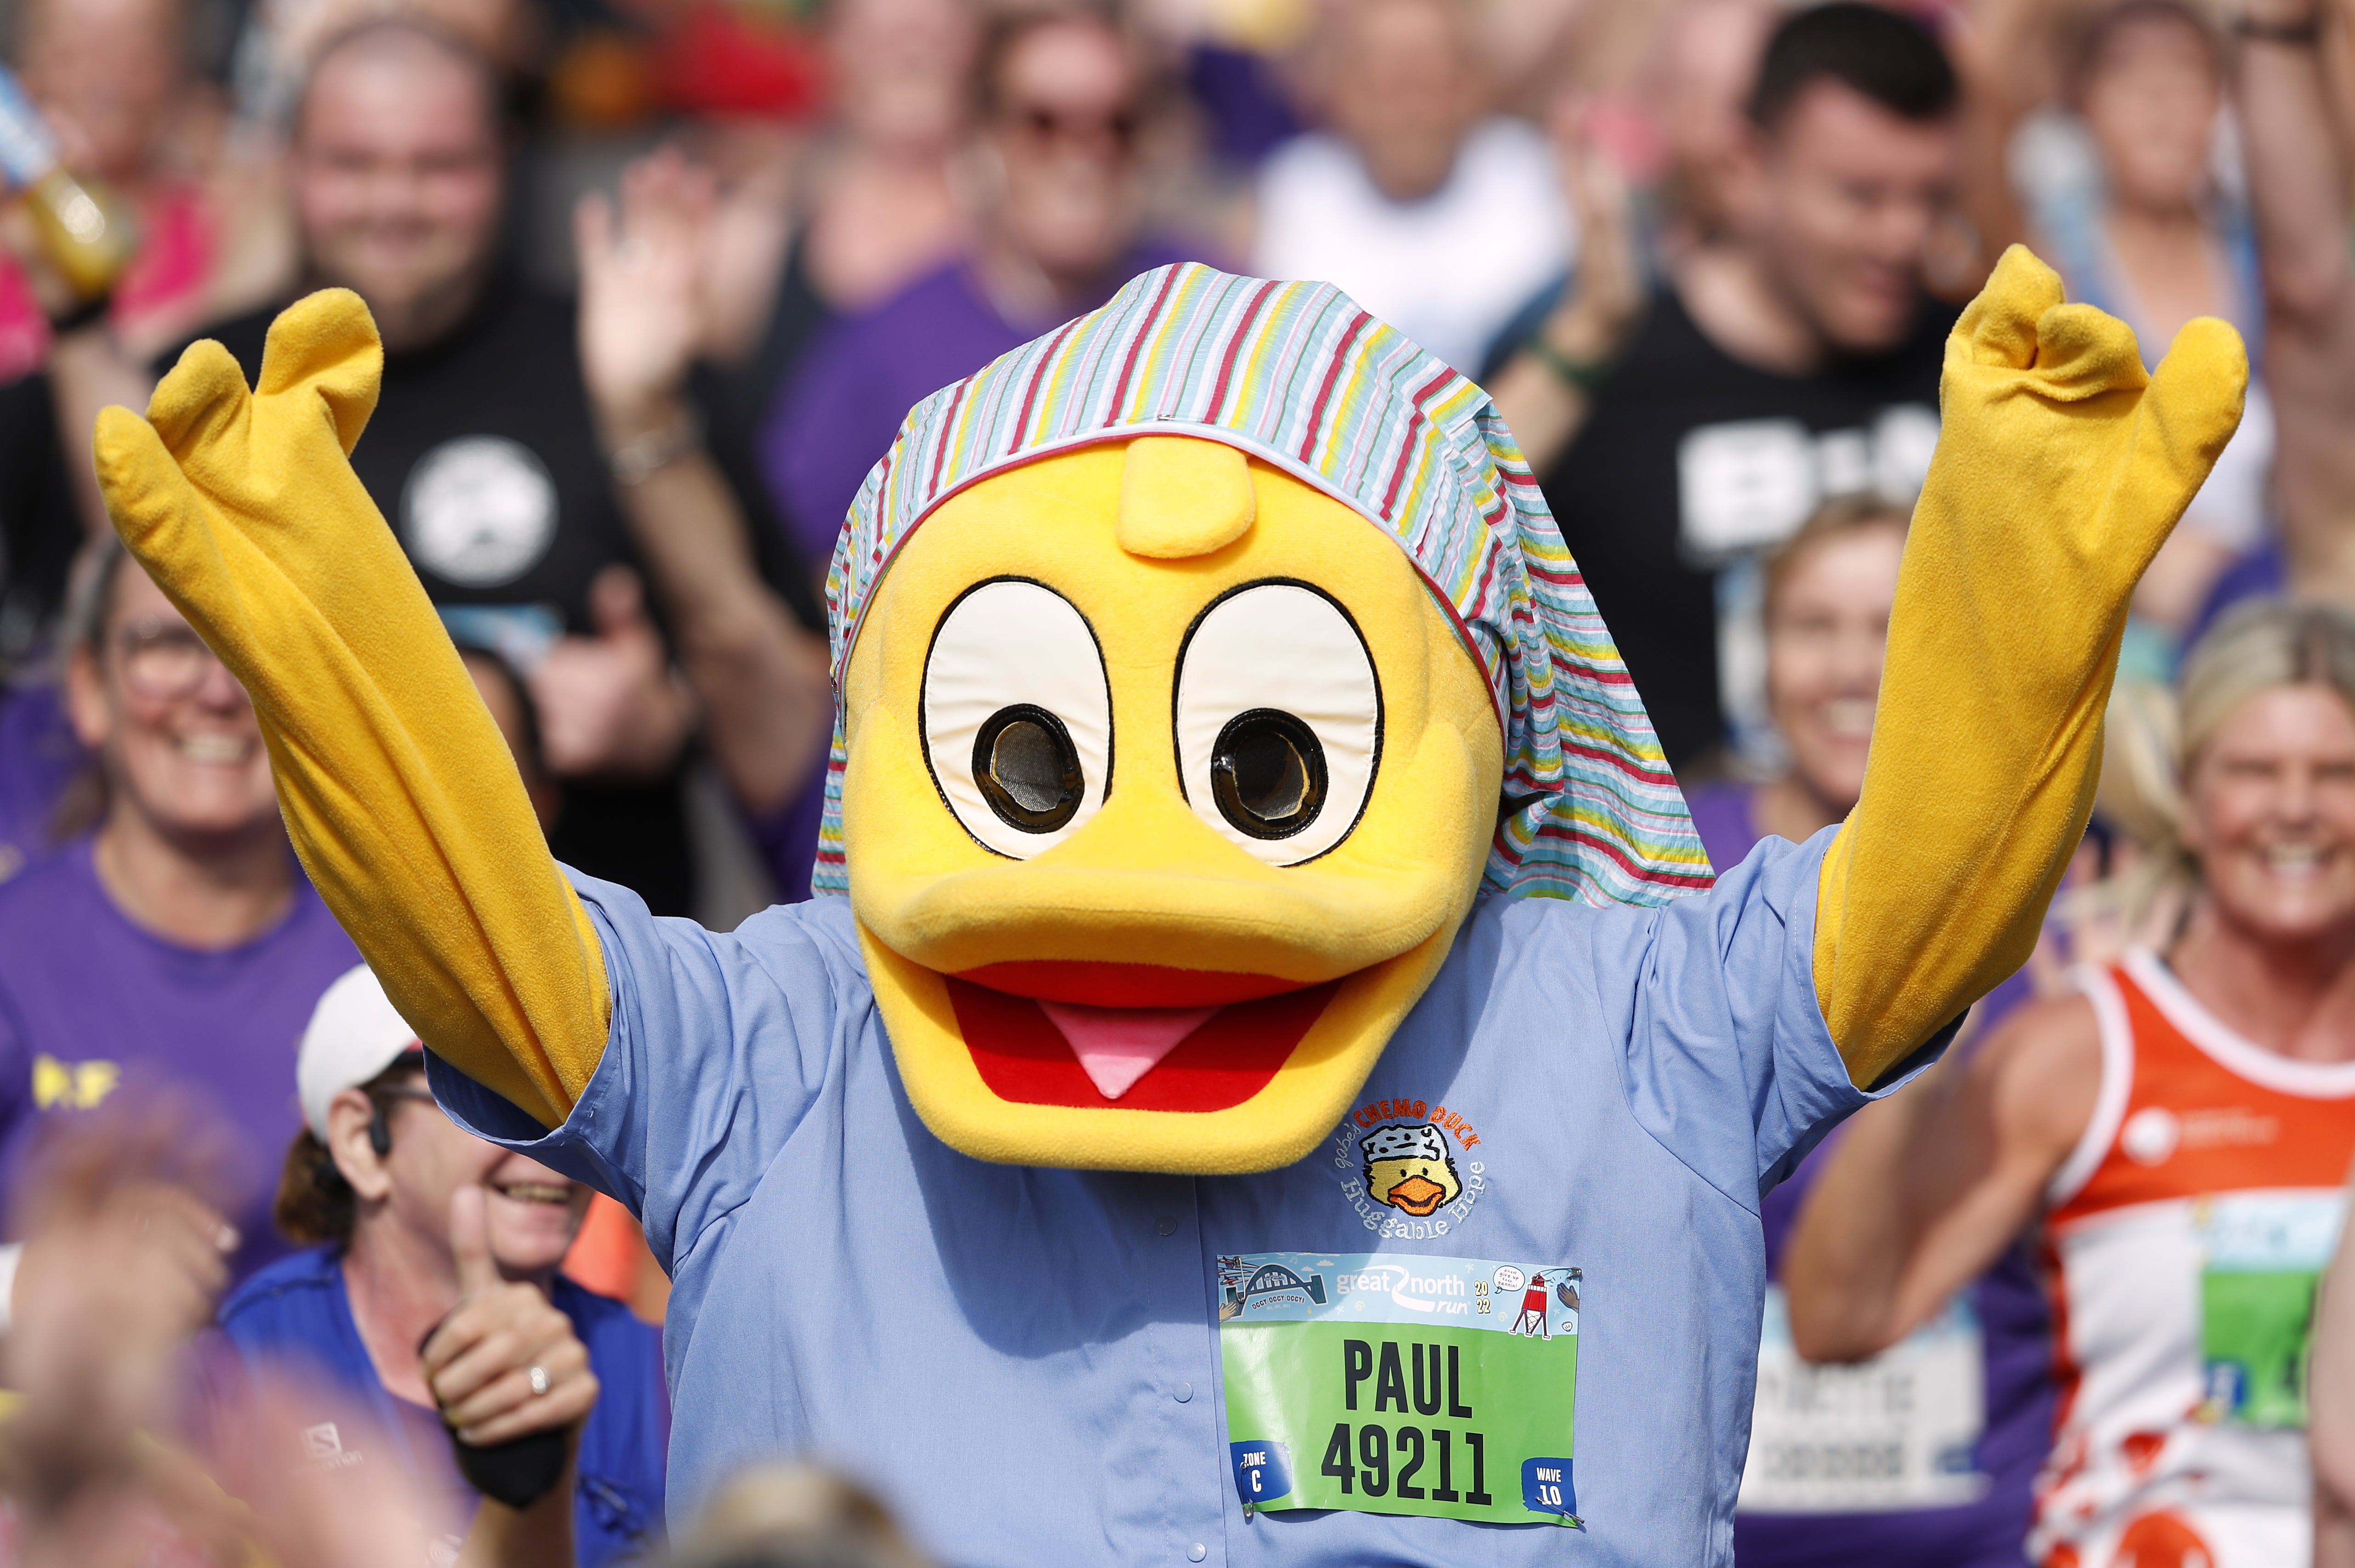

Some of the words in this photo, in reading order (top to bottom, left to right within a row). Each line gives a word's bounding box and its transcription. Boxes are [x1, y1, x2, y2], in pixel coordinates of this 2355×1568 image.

[1334, 1123, 1361, 1169] gabe's
[1354, 1098, 1427, 1128] CHEMO
[1428, 1106, 1481, 1151] DUCK
[1340, 1177, 1451, 1239] Huggable
[1448, 1161, 1486, 1224] Hope
[1337, 1272, 1390, 1294] great
[1411, 1275, 1465, 1296] north
[1474, 1281, 1488, 1296] 20
[1252, 1298, 1267, 1310] OCCY
[1287, 1295, 1305, 1303] OCCY!
[1437, 1300, 1468, 1315] run
[1477, 1298, 1490, 1313] 22
[1343, 1339, 1472, 1419] PAUL
[1243, 1451, 1266, 1466] ZONE
[1321, 1423, 1492, 1506] 49211
[1251, 1469, 1262, 1493] C
[1536, 1467, 1562, 1483] WAVE
[1540, 1484, 1562, 1506] 10
